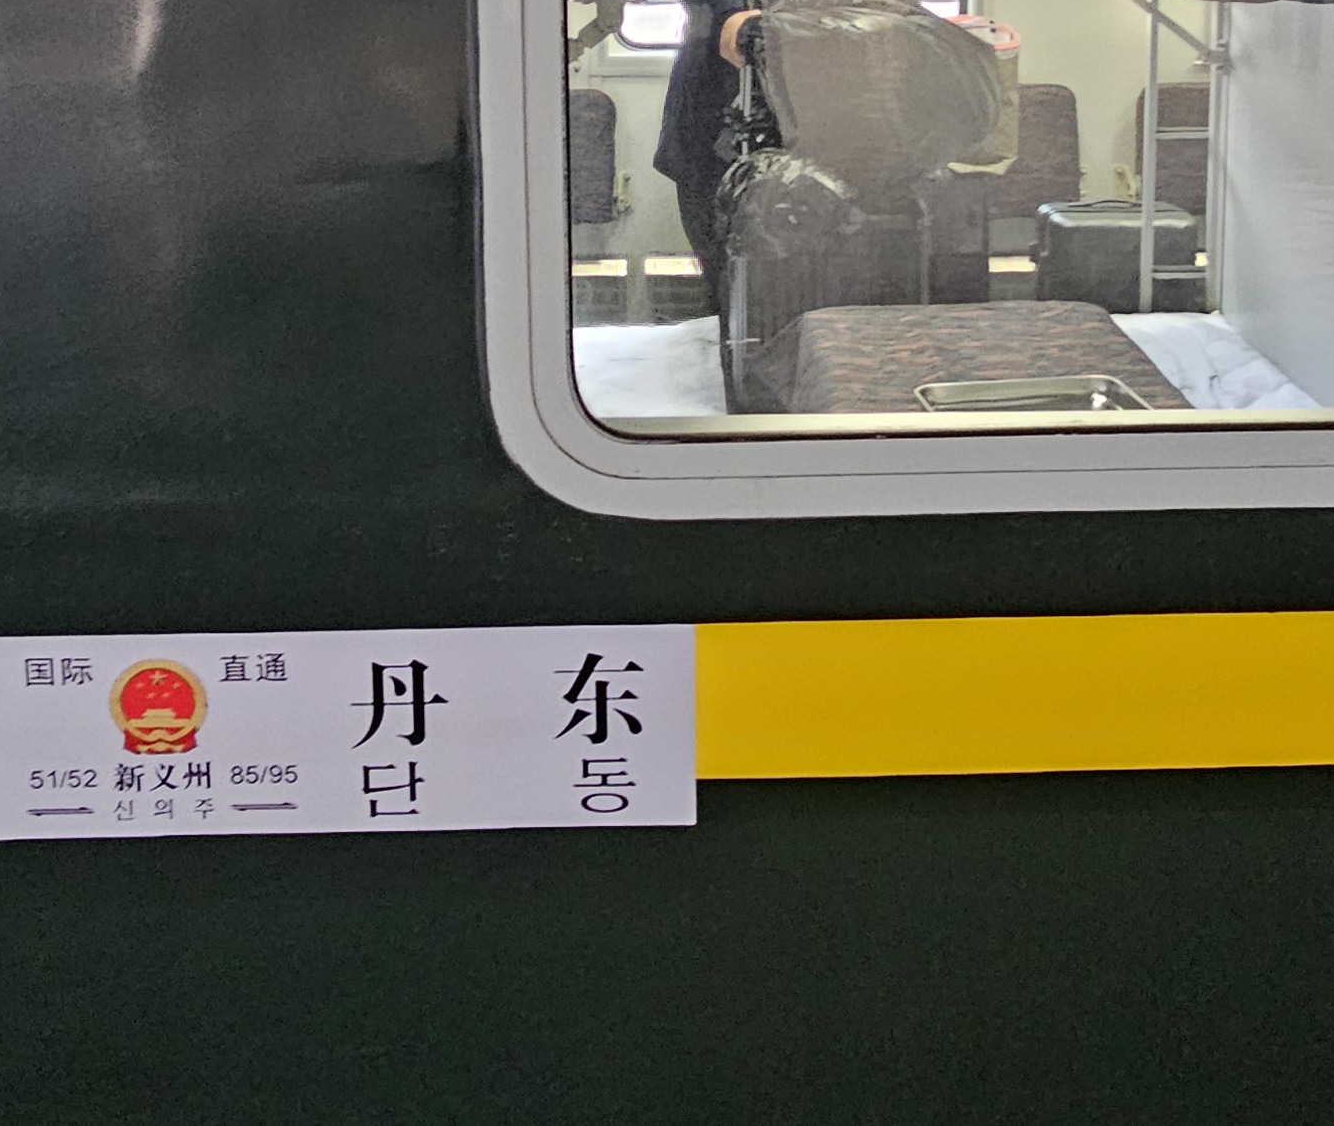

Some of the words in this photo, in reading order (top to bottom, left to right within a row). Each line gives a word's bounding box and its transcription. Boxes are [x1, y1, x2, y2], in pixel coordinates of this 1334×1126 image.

[25, 658, 95, 688] 国际
[219, 653, 289, 685] 直通
[30, 769, 99, 791] 51/52
[115, 761, 213, 794] 新义州
[230, 765, 300, 786] 85/95
